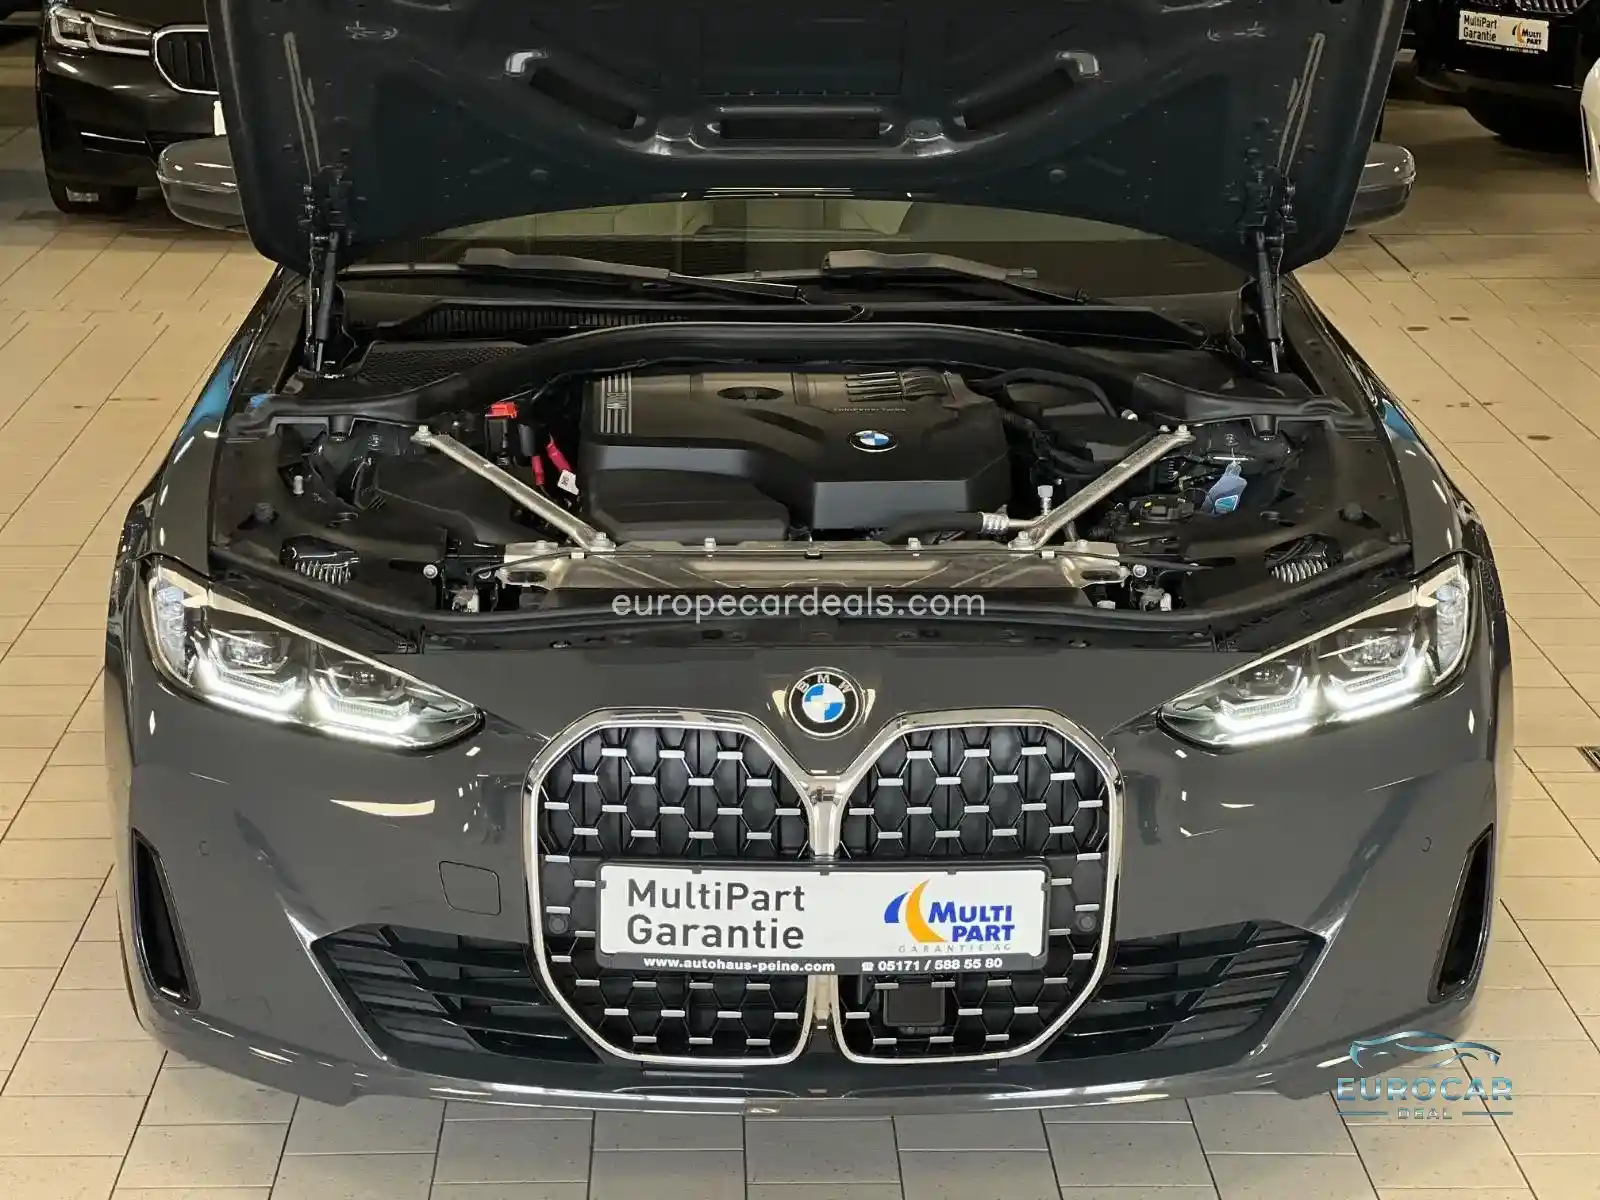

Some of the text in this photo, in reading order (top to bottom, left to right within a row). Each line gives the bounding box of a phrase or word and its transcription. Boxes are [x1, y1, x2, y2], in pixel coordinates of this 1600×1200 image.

[1464, 14, 1497, 29] MultiPart
[1463, 27, 1497, 42] Garantie
[795, 674, 853, 693] BMW
[628, 878, 805, 912] MultiPart
[928, 901, 1013, 923] MULTI
[627, 914, 804, 949] Garantie
[952, 924, 1015, 942] PART
[898, 943, 1011, 953] GARANTIE AG
[643, 956, 836, 973] www.autohaus-peine.com
[878, 960, 920, 972] 05171
[934, 959, 961, 970] 588
[964, 958, 981, 969] 55
[985, 957, 1003, 969] 80
